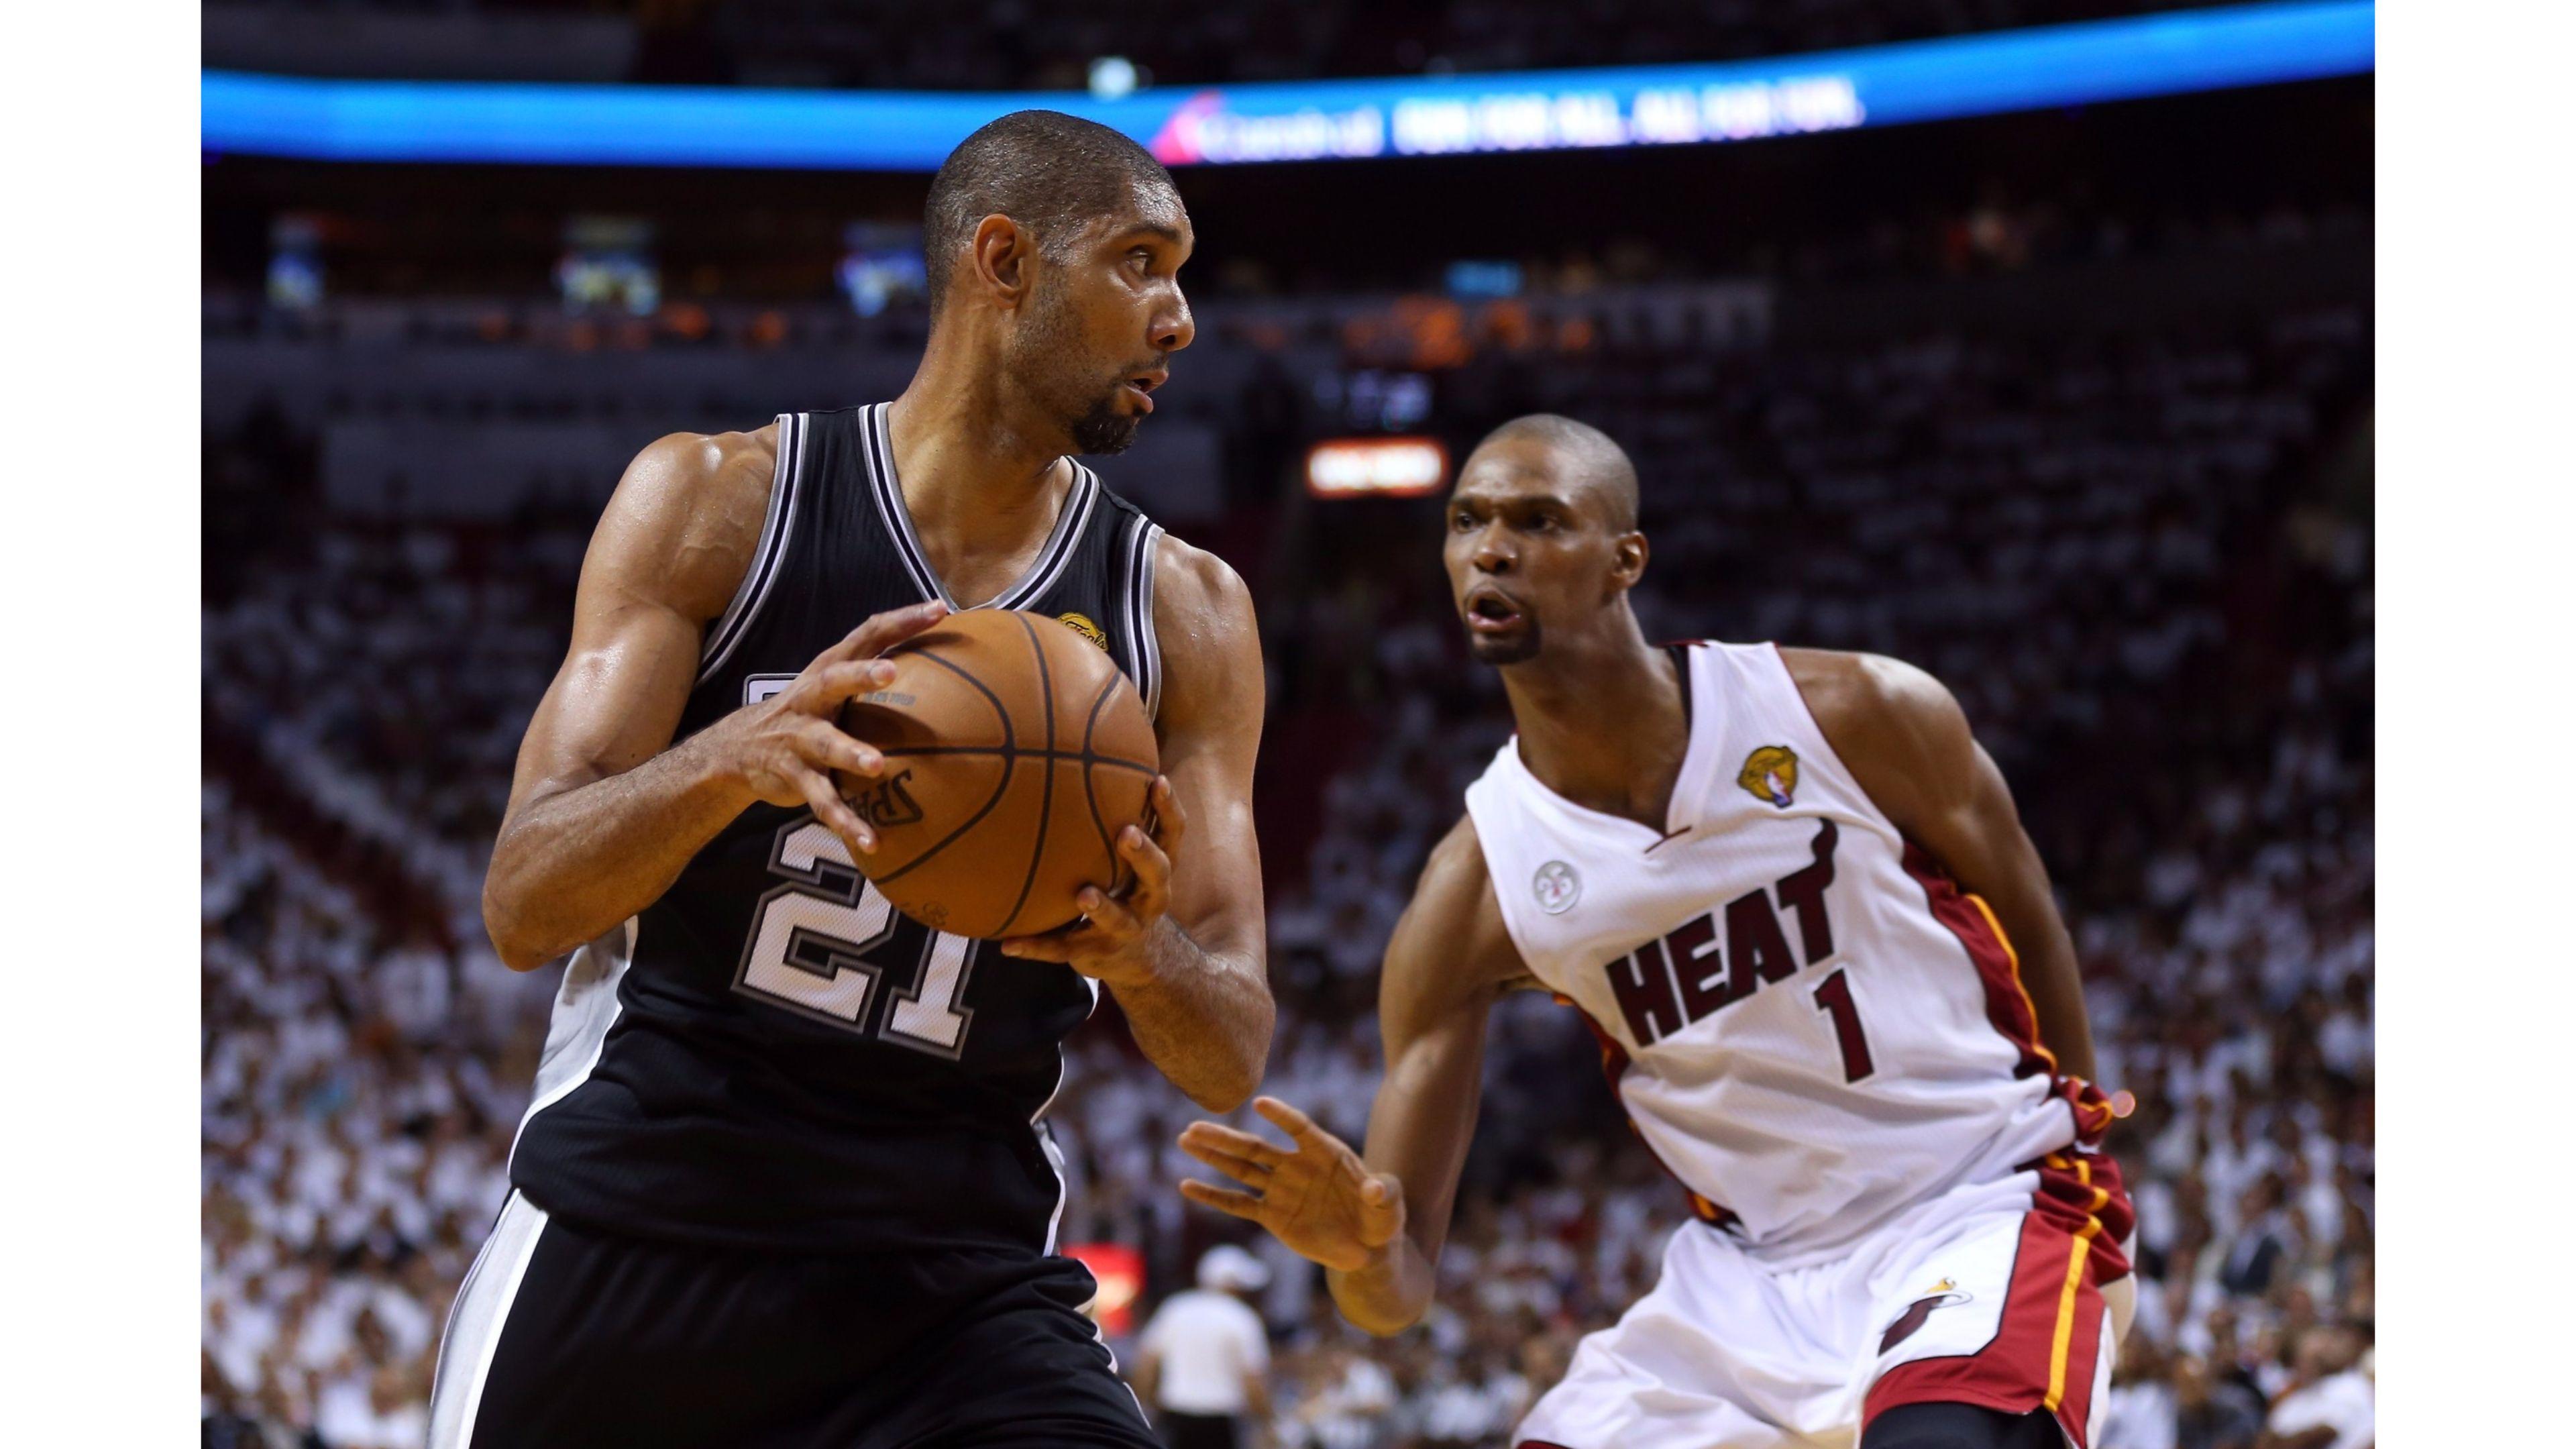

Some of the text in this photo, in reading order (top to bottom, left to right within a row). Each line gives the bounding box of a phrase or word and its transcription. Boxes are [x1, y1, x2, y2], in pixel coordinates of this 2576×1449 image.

[731, 813, 979, 1061] 21
[1604, 816, 1839, 1048] HEAT
[1813, 967, 1874, 1084] 1
